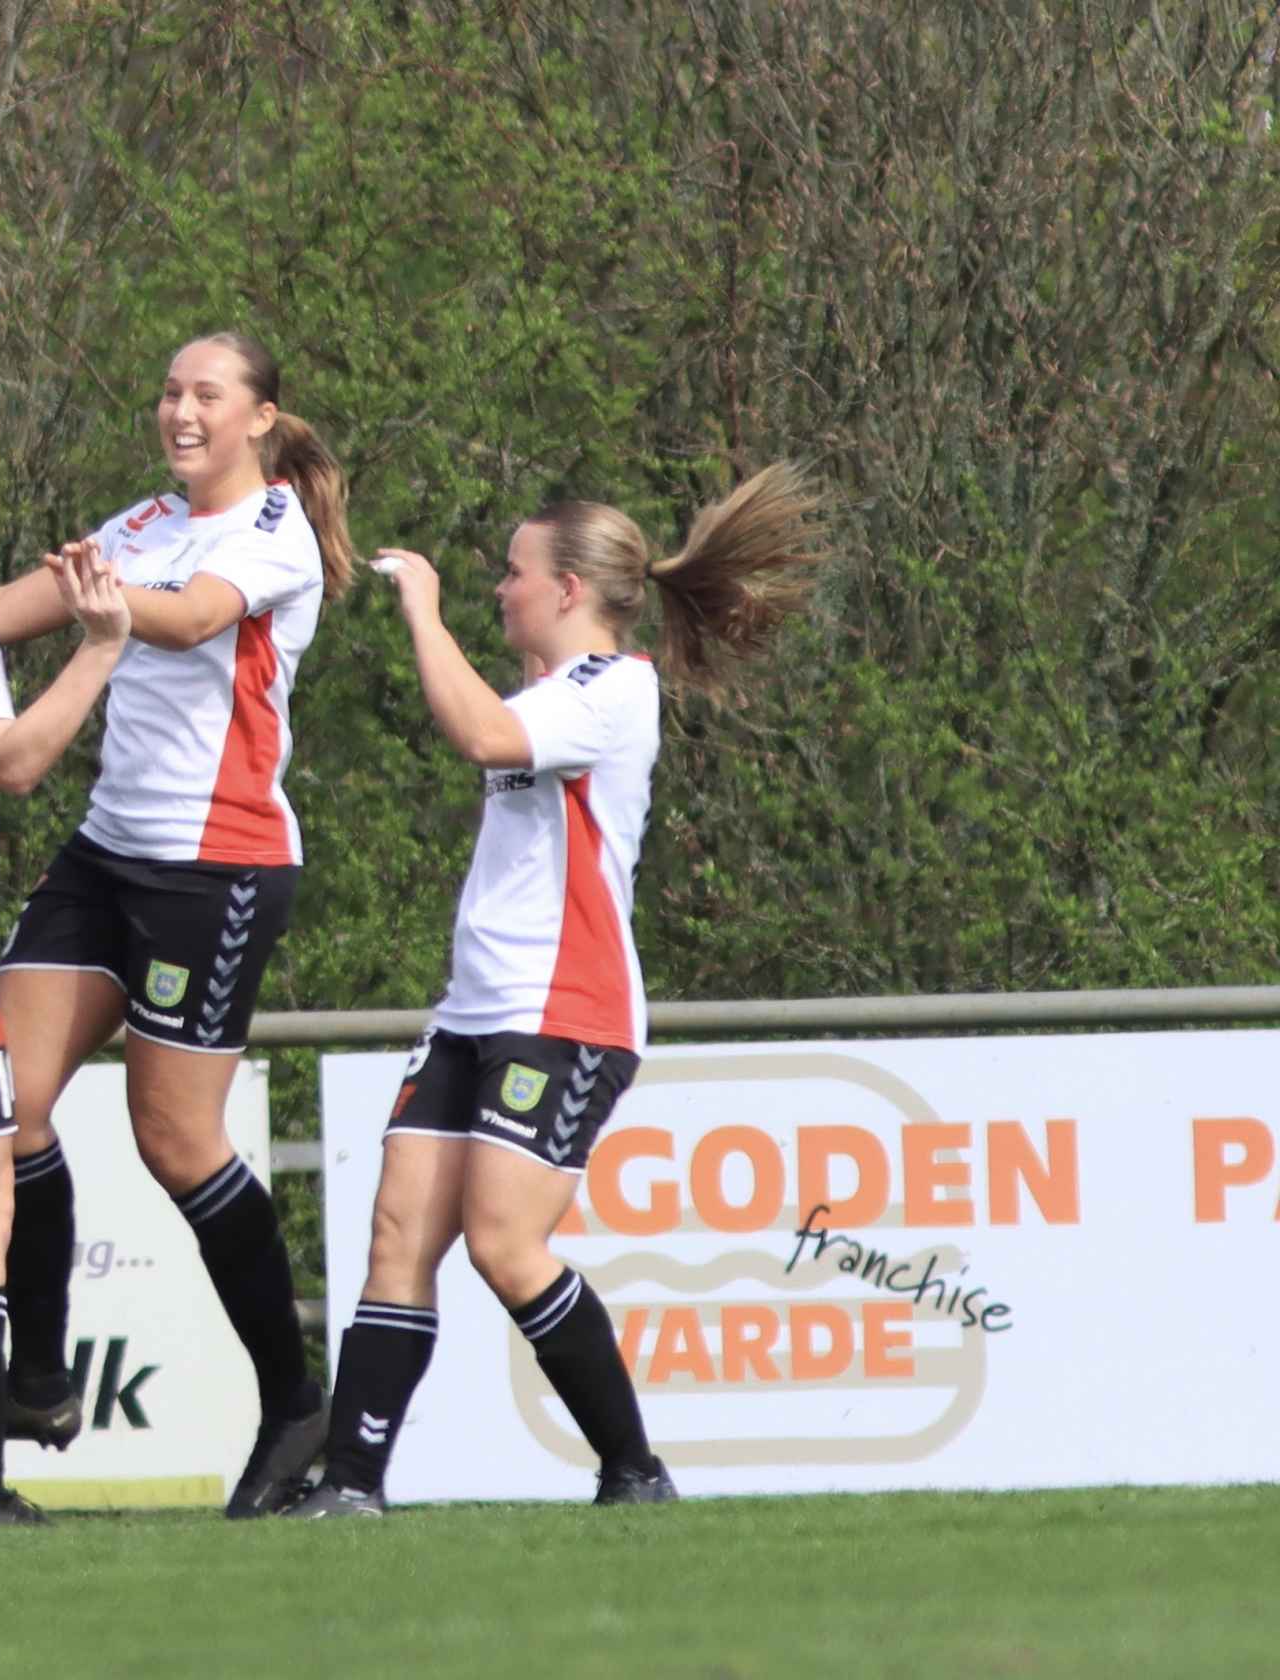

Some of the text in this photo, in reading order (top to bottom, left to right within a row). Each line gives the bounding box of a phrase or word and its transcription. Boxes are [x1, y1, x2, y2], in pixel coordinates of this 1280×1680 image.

[553, 1117, 1280, 1238] GODEN P
[785, 1204, 1014, 1332] franchise
